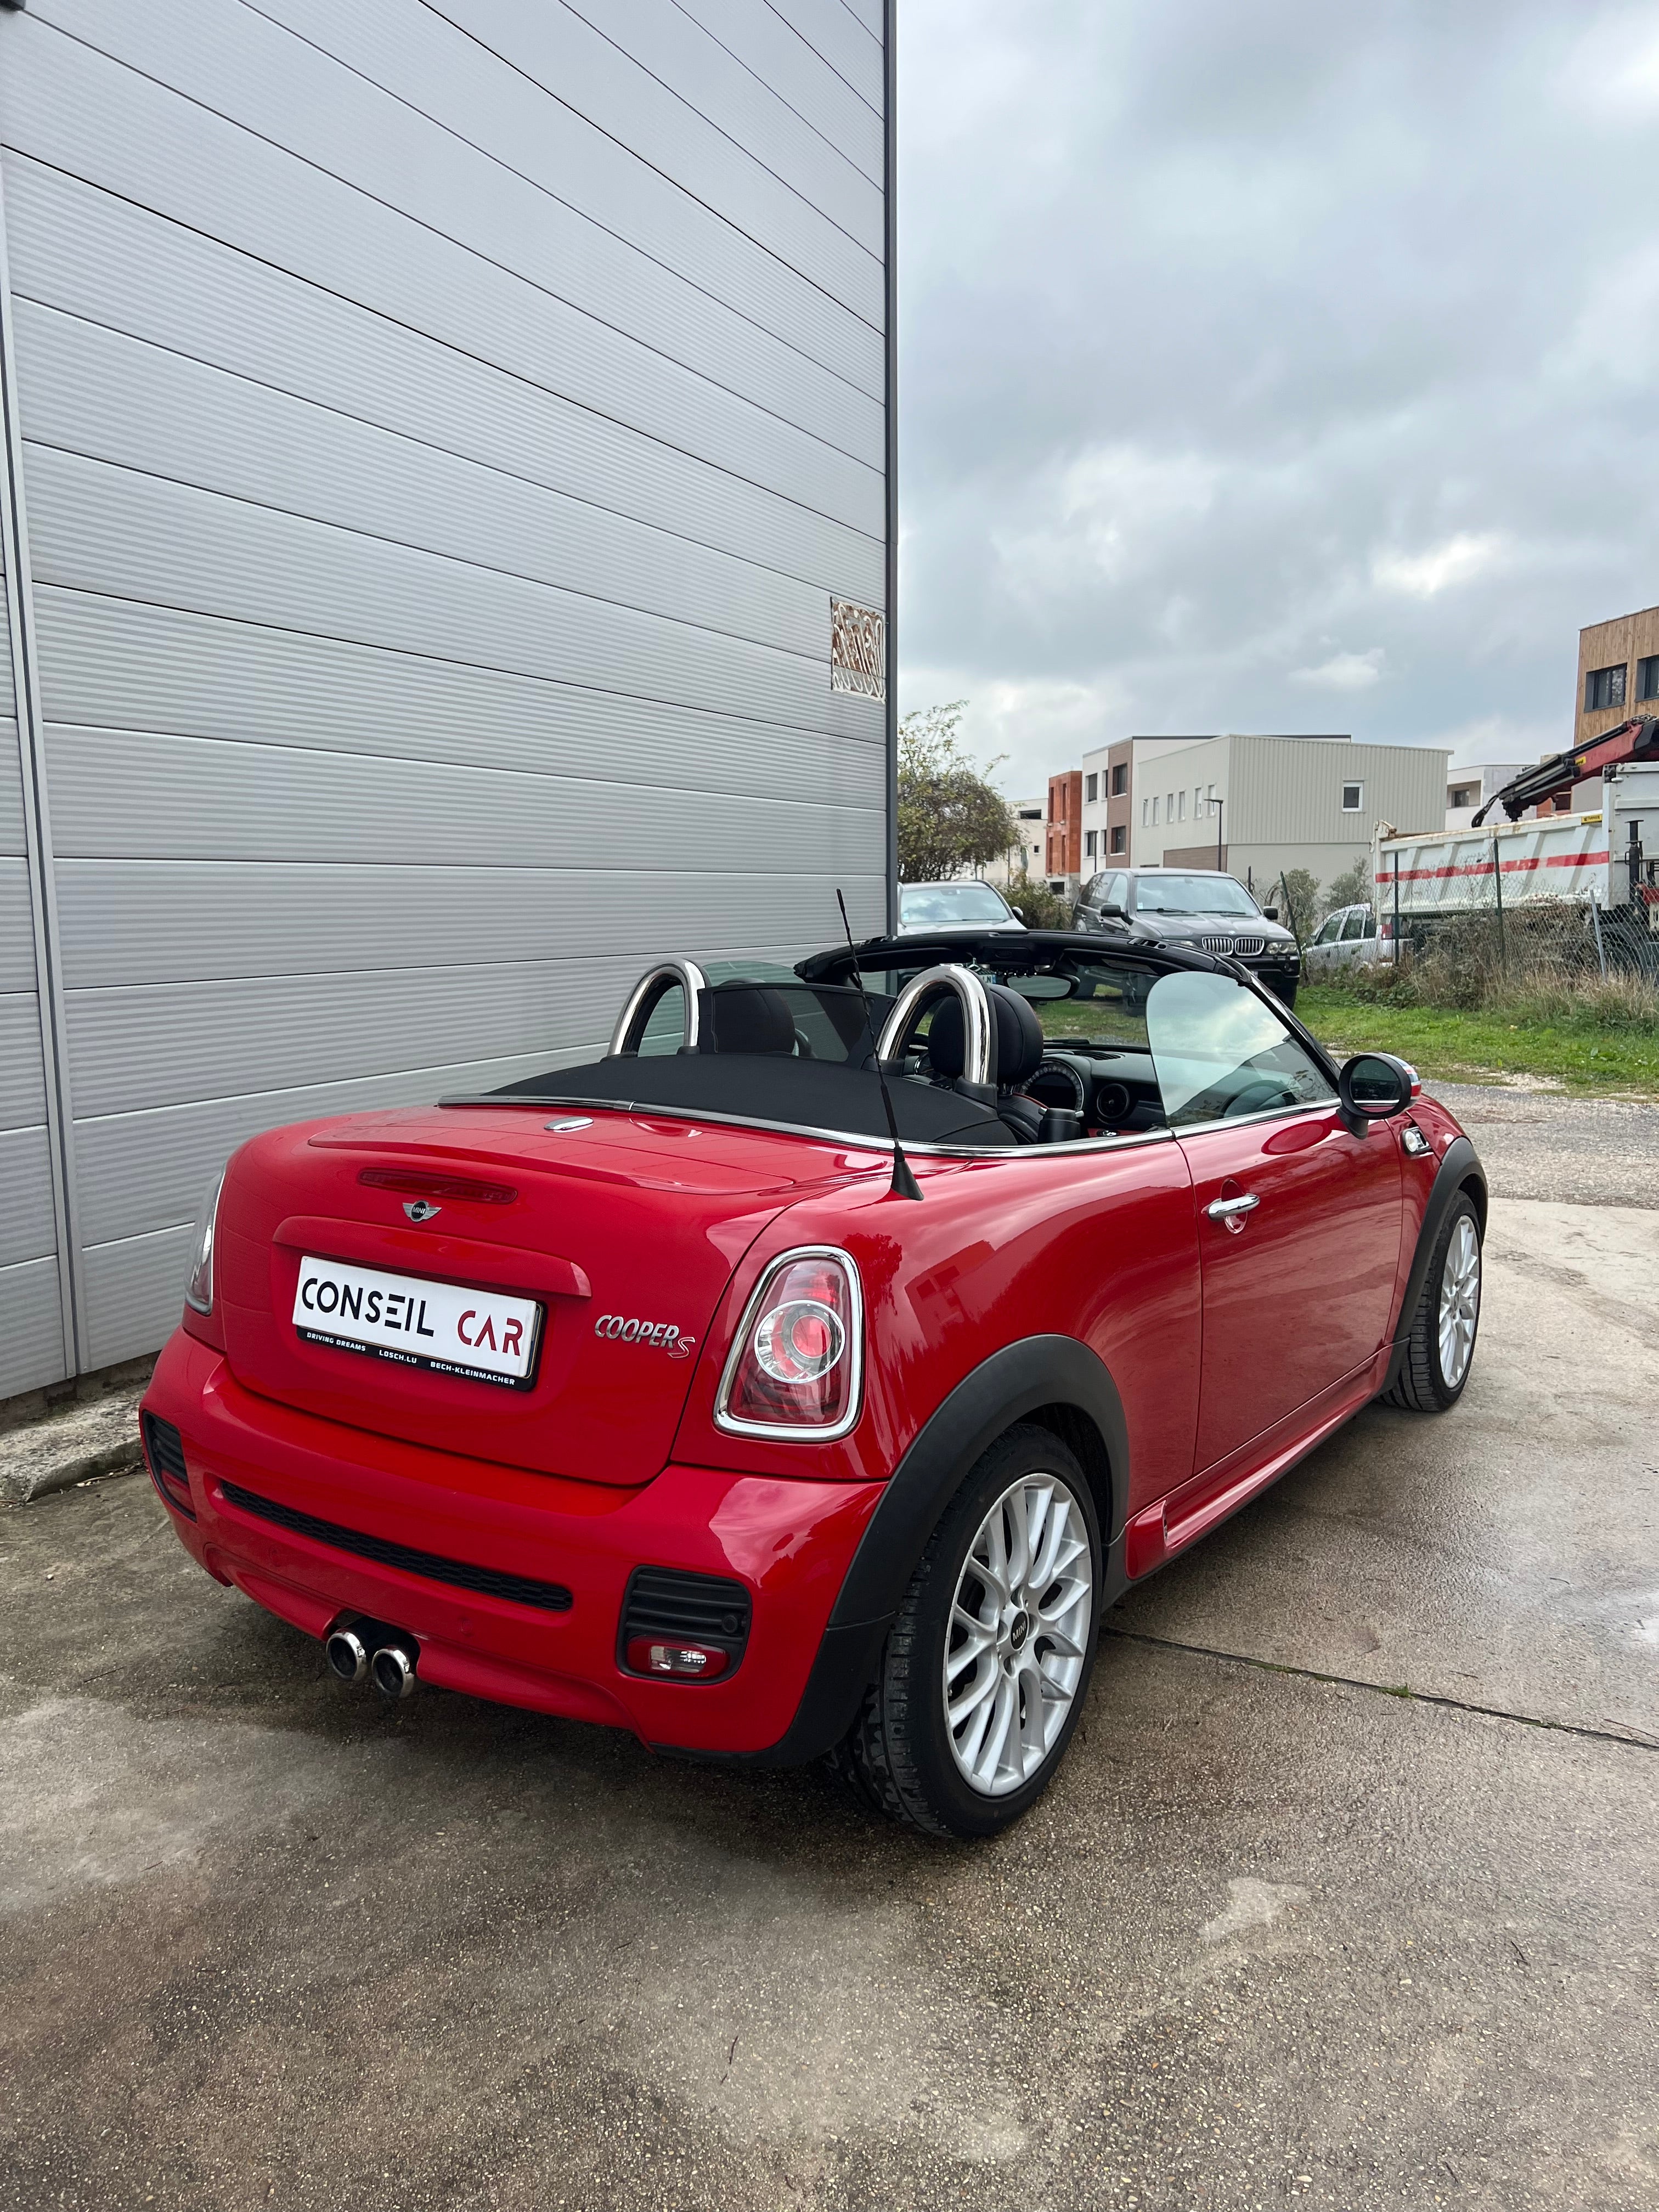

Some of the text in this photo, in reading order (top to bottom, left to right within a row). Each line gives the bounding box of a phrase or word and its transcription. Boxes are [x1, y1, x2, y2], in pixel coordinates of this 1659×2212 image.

[302, 1278, 523, 1357] CONSEIL CAR
[595, 1314, 696, 1358] COOPER S
[307, 1332, 515, 1385] DRIVING DREAMS LOSCH.LU BECH-KLEINMACHER
[1012, 1620, 1026, 1642] MINI
